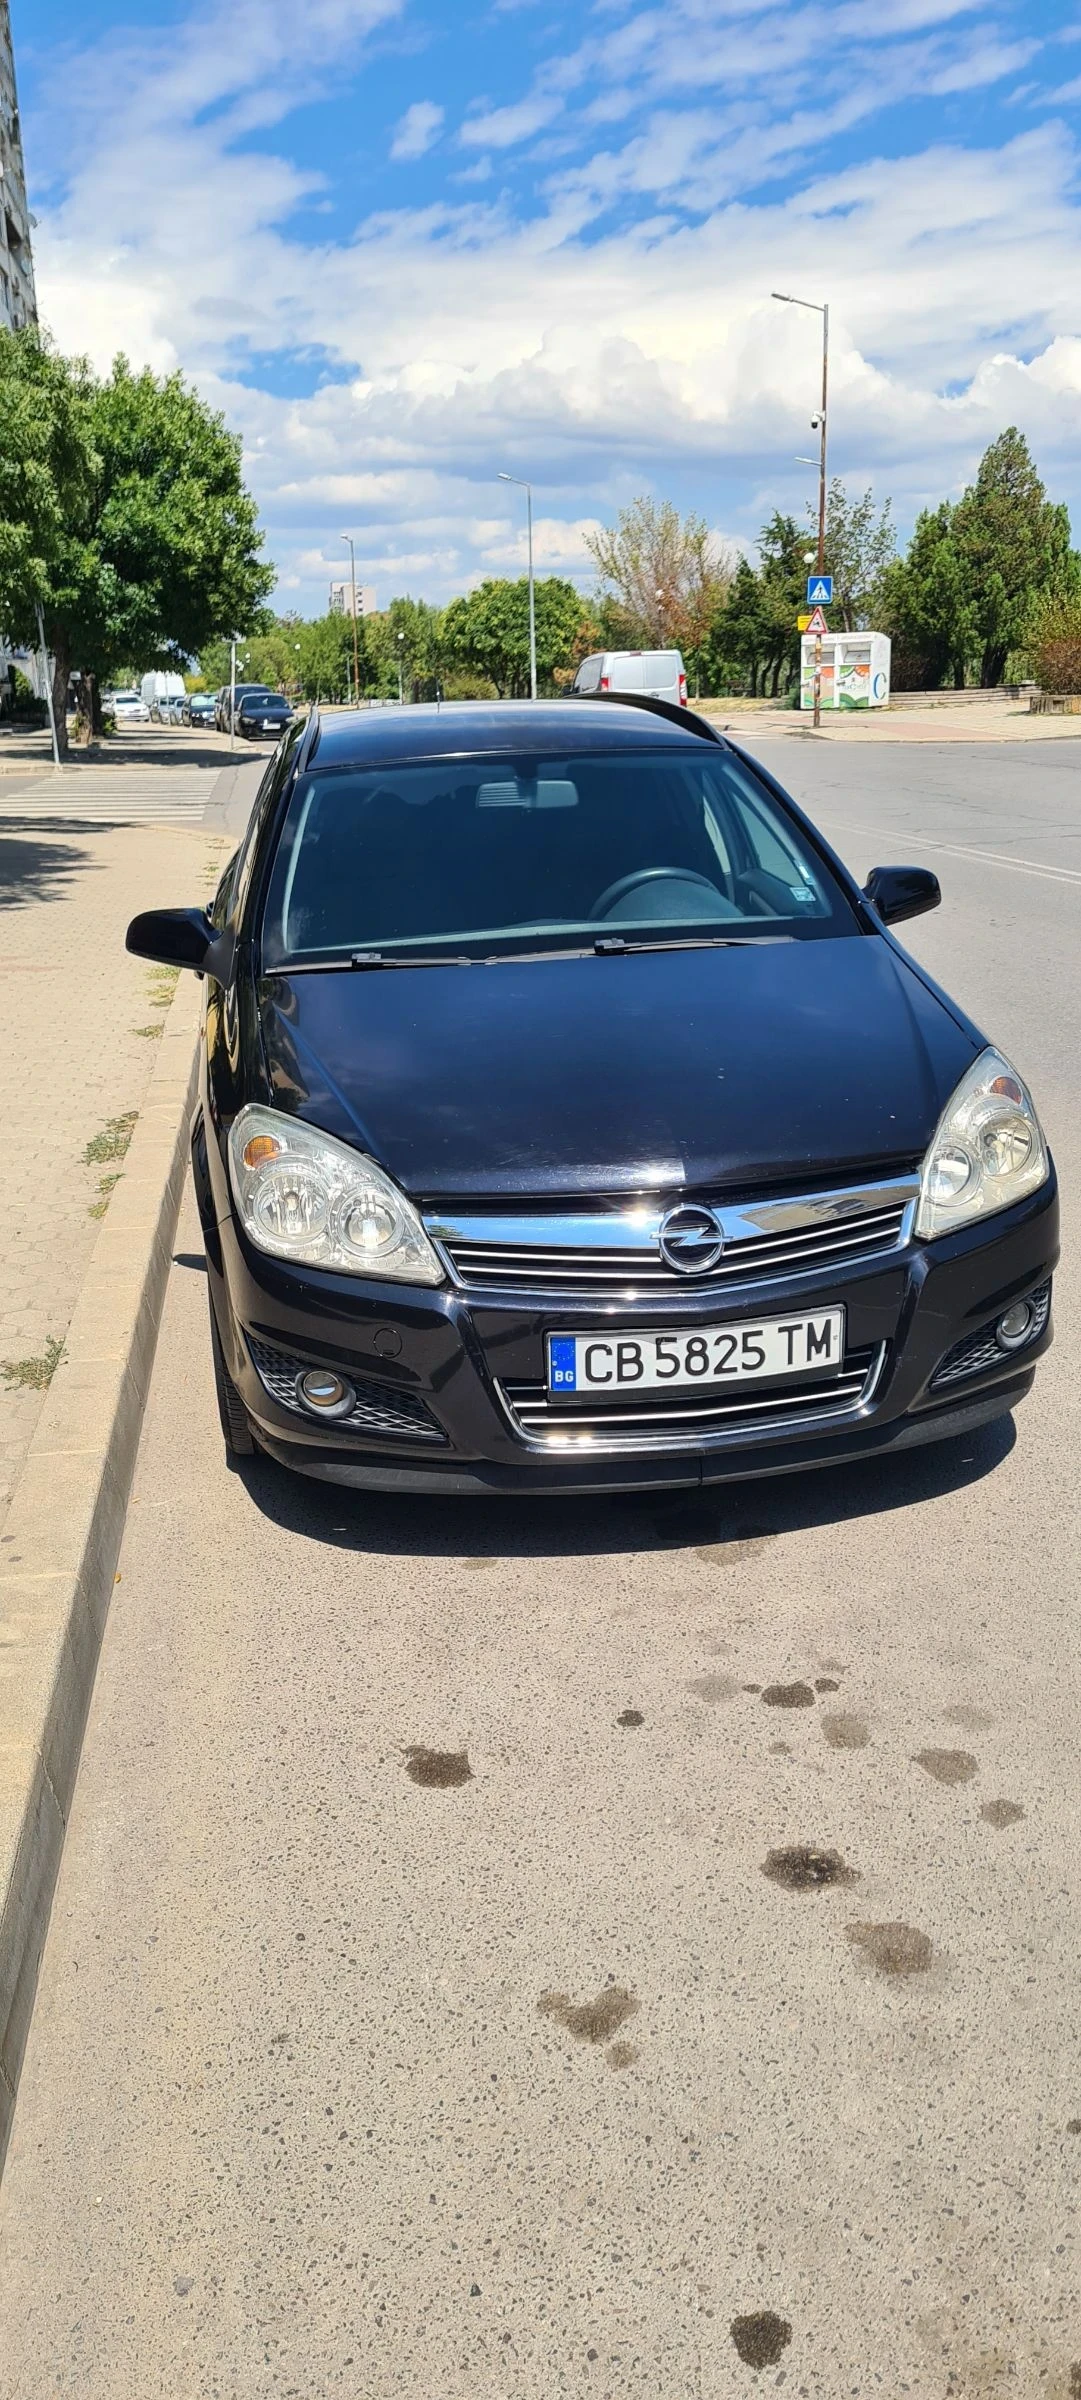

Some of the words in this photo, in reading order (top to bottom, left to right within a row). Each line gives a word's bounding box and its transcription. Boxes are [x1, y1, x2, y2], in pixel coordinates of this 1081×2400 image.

[584, 1342, 644, 1383] CB
[655, 1330, 766, 1379] 5825
[778, 1319, 832, 1366] TM
[554, 1370, 574, 1383] BG
